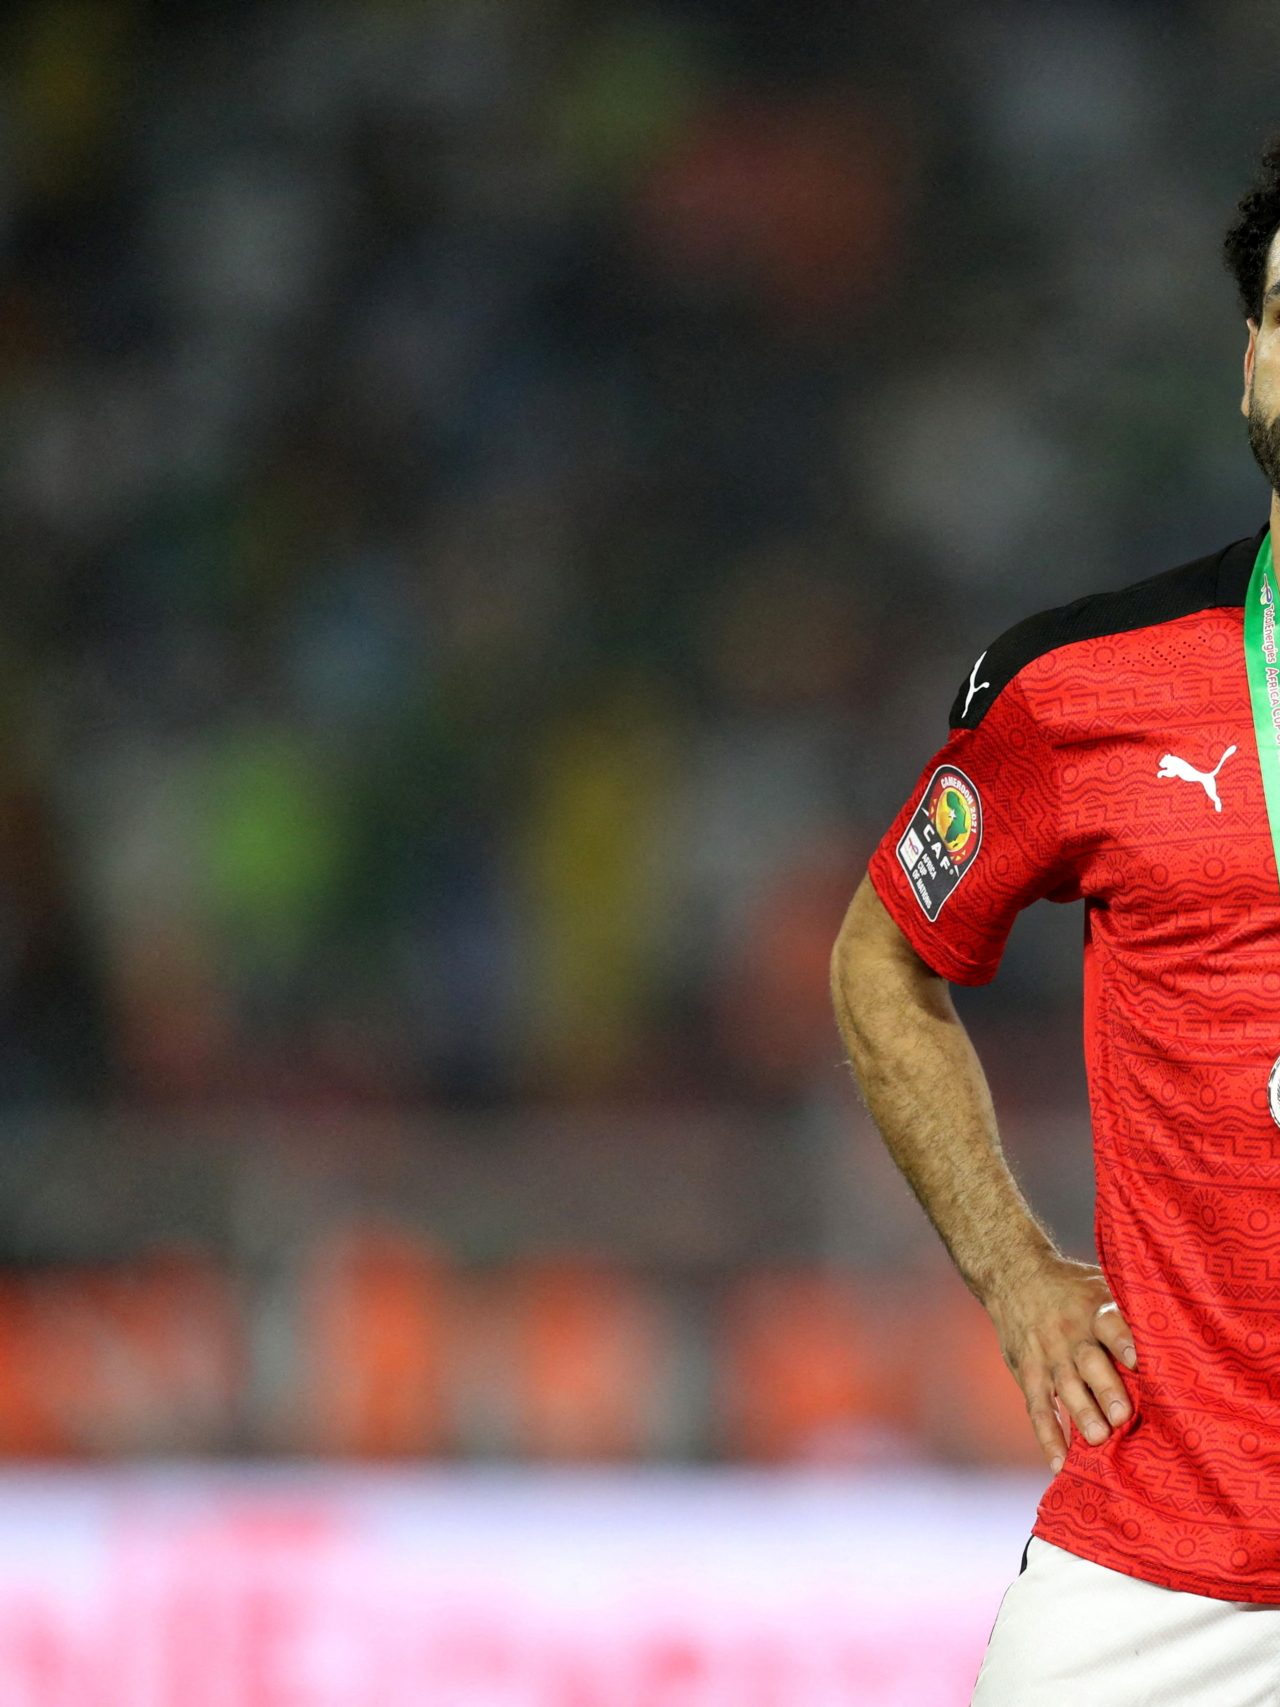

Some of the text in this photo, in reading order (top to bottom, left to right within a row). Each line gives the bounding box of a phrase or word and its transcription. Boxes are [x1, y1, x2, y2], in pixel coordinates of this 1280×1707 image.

[940, 776, 978, 833] CAMEROON 2021
[922, 853, 937, 880] AFRICA
[923, 824, 951, 870] CAF
[917, 861, 928, 876] CUP
[912, 869, 932, 909] OF NATIONS
